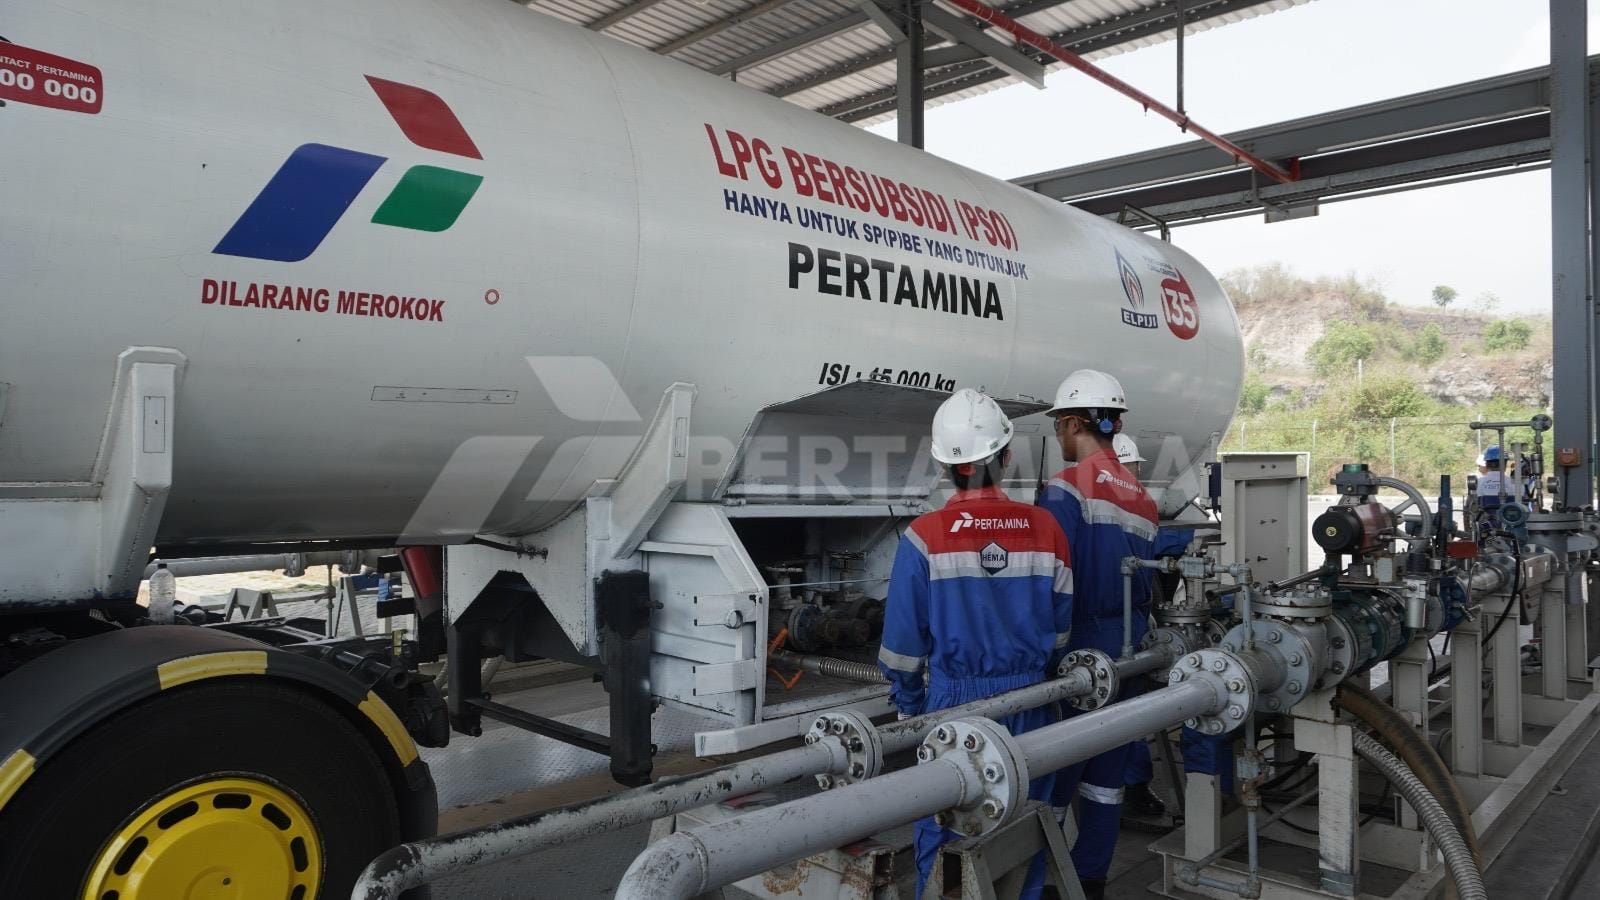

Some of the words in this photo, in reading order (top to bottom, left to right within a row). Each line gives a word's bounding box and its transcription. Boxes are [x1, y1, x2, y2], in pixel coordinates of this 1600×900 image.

[0, 68, 35, 91] 00
[44, 79, 97, 104] 000
[35, 64, 95, 84] PERTAMINA
[704, 123, 783, 190] LPG
[782, 146, 958, 236] BERSUBSIDI
[953, 199, 1019, 252] (PSO)
[724, 189, 793, 225] HANYA
[797, 206, 860, 240] UNTUK
[863, 223, 923, 254] SP(P)BE
[926, 237, 963, 265] YANG
[965, 248, 1029, 281] DITUNJUK
[202, 279, 330, 313] DILARANG
[337, 290, 446, 322] MEROKOK
[788, 242, 1004, 321] PERTAMINA
[1123, 311, 1157, 328] ELPIJI
[1161, 287, 1197, 330] 135
[818, 362, 850, 386] ISI
[974, 518, 1030, 530] PERTAMINA
